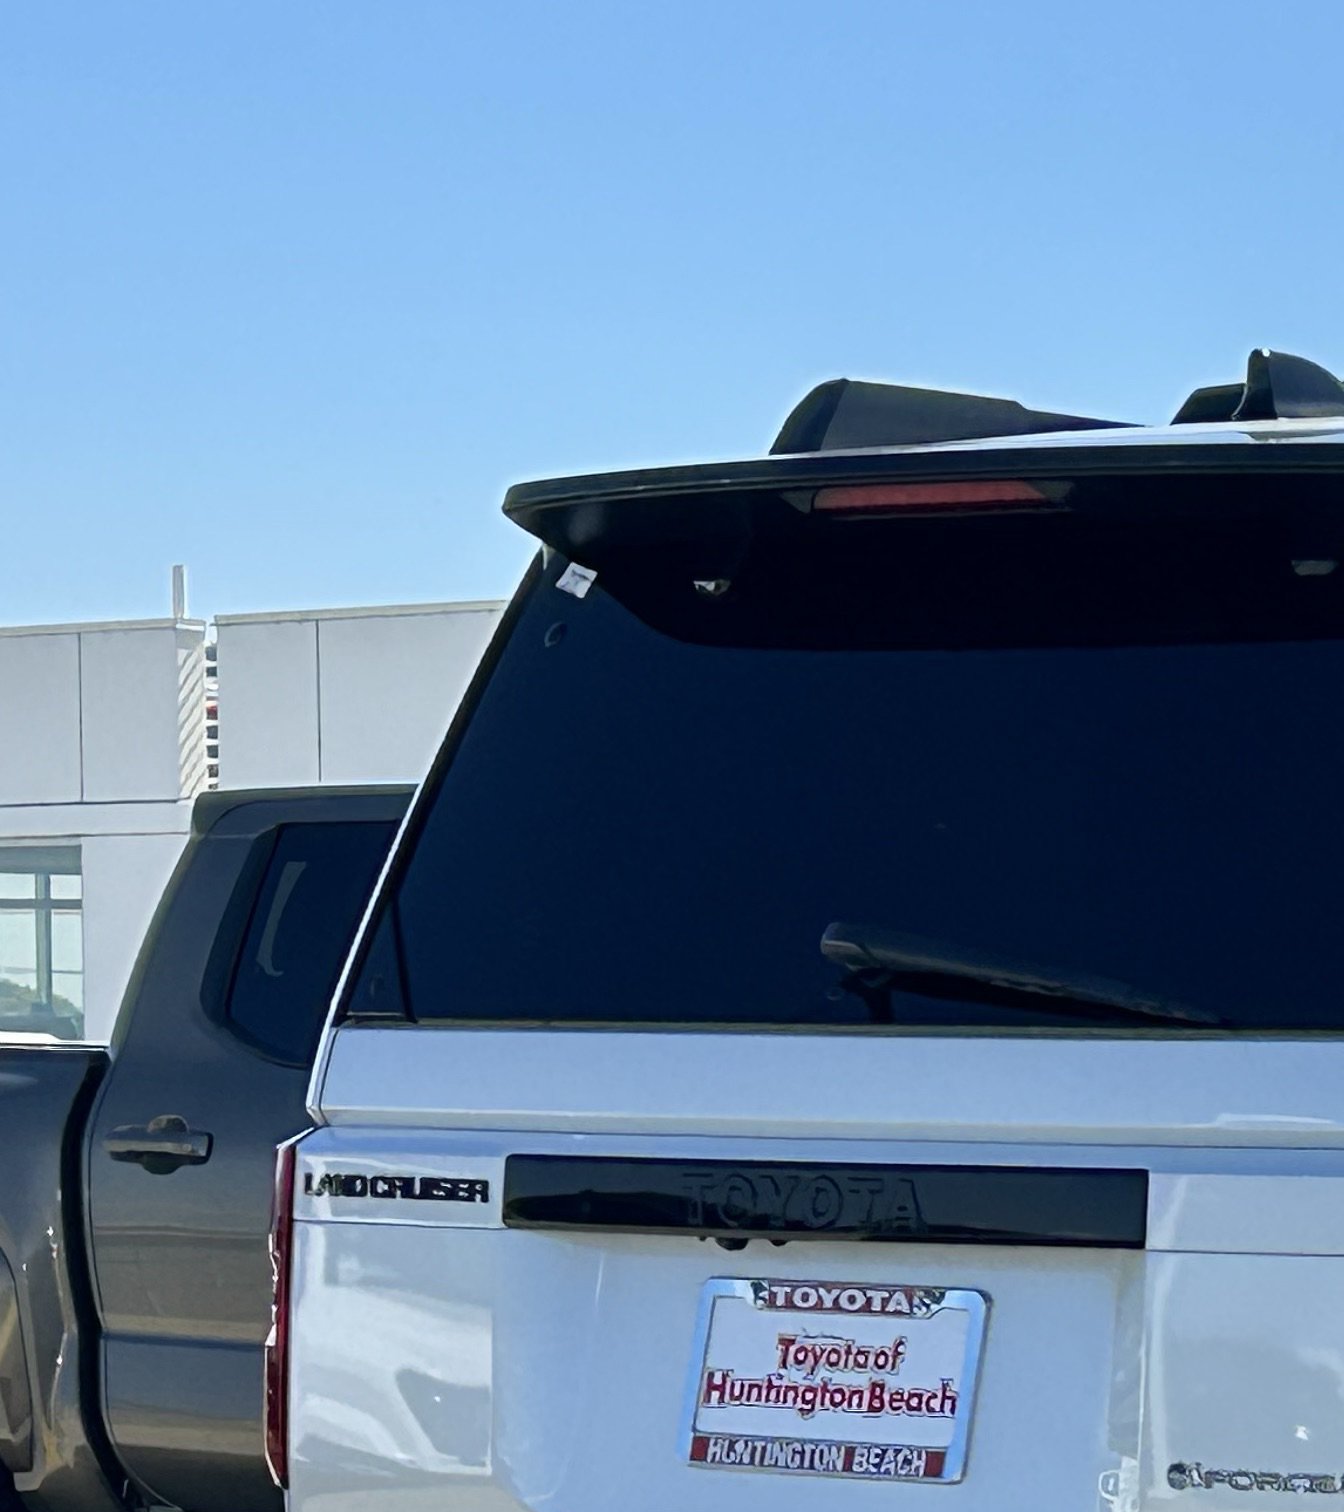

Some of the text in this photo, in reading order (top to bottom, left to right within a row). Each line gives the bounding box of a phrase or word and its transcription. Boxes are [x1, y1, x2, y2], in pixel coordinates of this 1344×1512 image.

[370, 1176, 489, 1203] CRUISER
[682, 1173, 928, 1233] TOYOTA
[771, 1286, 910, 1312] TOYOTA
[776, 1335, 906, 1377] Toyota of
[704, 1371, 957, 1417] Huntington Beach
[706, 1438, 928, 1477] HUNTINGTON BEACH
